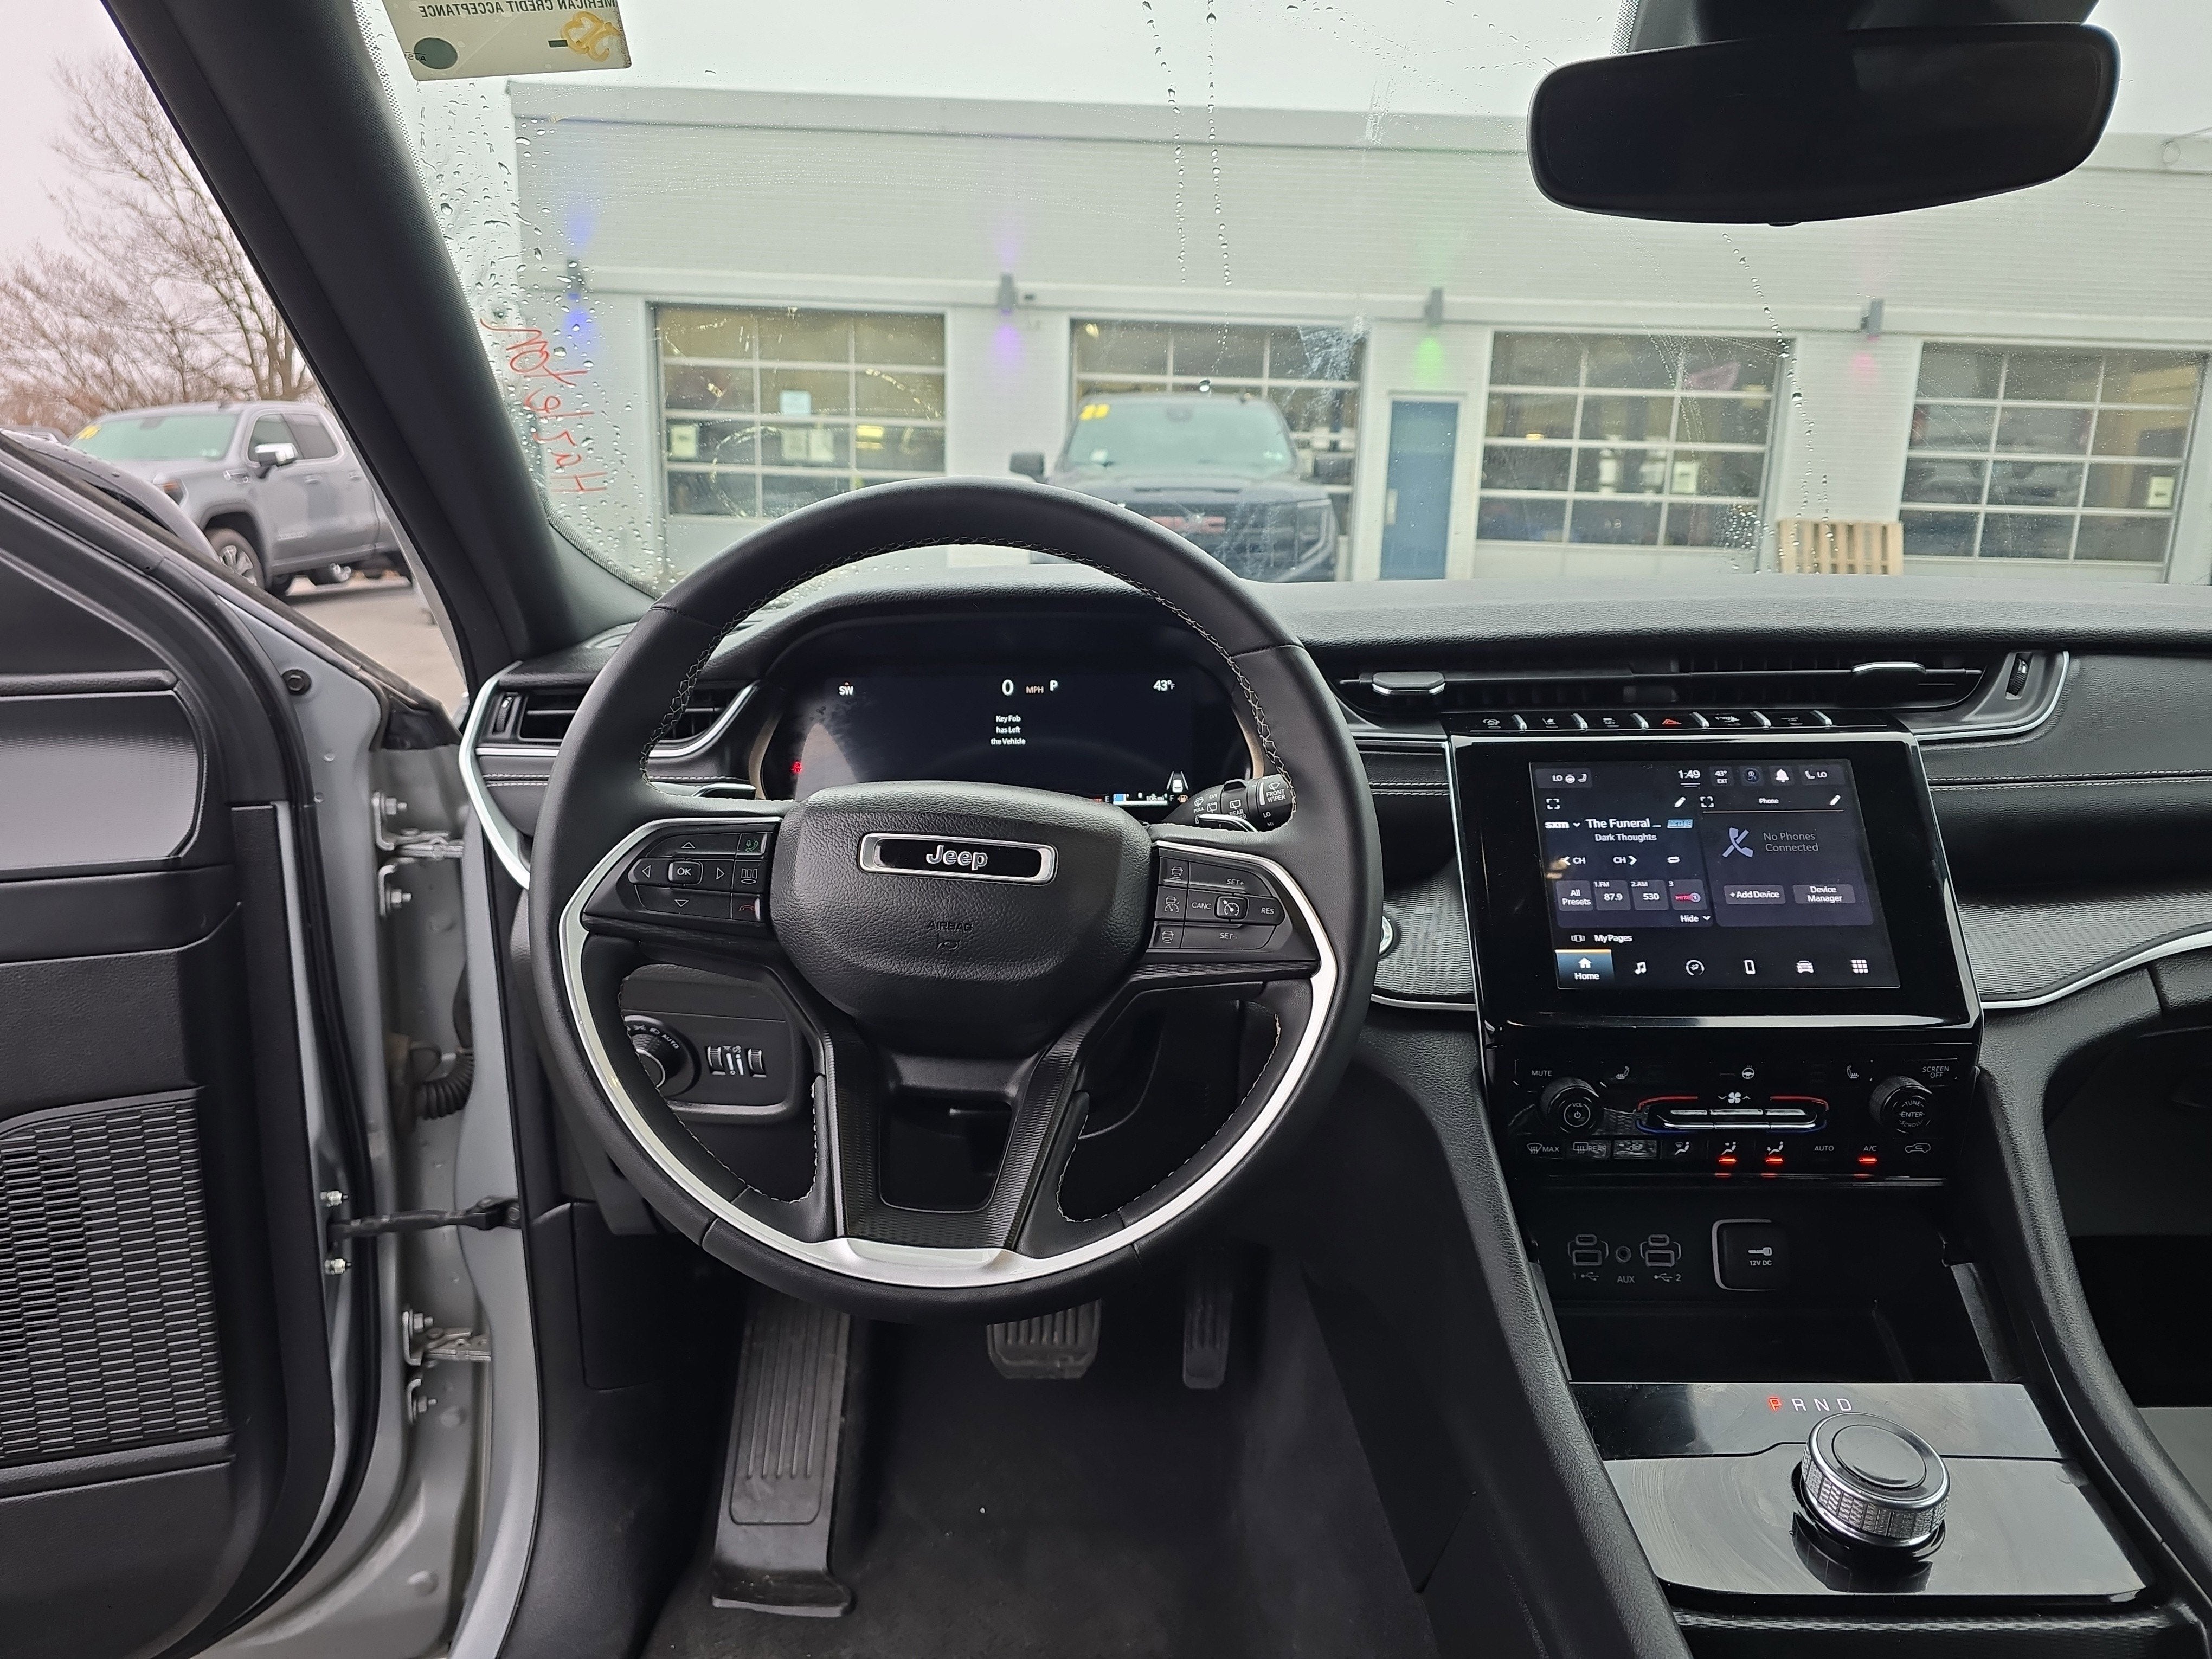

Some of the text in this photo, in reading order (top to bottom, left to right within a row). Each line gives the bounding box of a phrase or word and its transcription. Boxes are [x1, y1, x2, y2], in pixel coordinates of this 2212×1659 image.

[1002, 679, 1044, 696] 0 MPH
[1050, 680, 1058, 691] P
[839, 686, 854, 696] SW
[995, 715, 1008, 723] Key
[1678, 770, 1701, 779] 1:49
[1266, 789, 1285, 798] FRONT
[1266, 794, 1287, 803] WIPER
[1585, 819, 1607, 828] The
[1609, 818, 1650, 828] Funeral
[1594, 833, 1657, 843] Dark Thoughts
[1763, 832, 1816, 841] No Phones
[1765, 843, 1819, 852] Connected
[925, 845, 988, 871] Jeep
[677, 867, 692, 877] OK
[1753, 890, 1780, 898] Device
[1807, 895, 1843, 903] Manager
[1191, 902, 1212, 910] CANC
[927, 921, 974, 933] AIRBAG
[1594, 935, 1633, 943] My Pages
[1617, 1275, 1635, 1283] AUX
[1791, 1398, 1806, 1411] R
[1814, 1398, 1830, 1411] N
[1837, 1398, 1852, 1411] D
